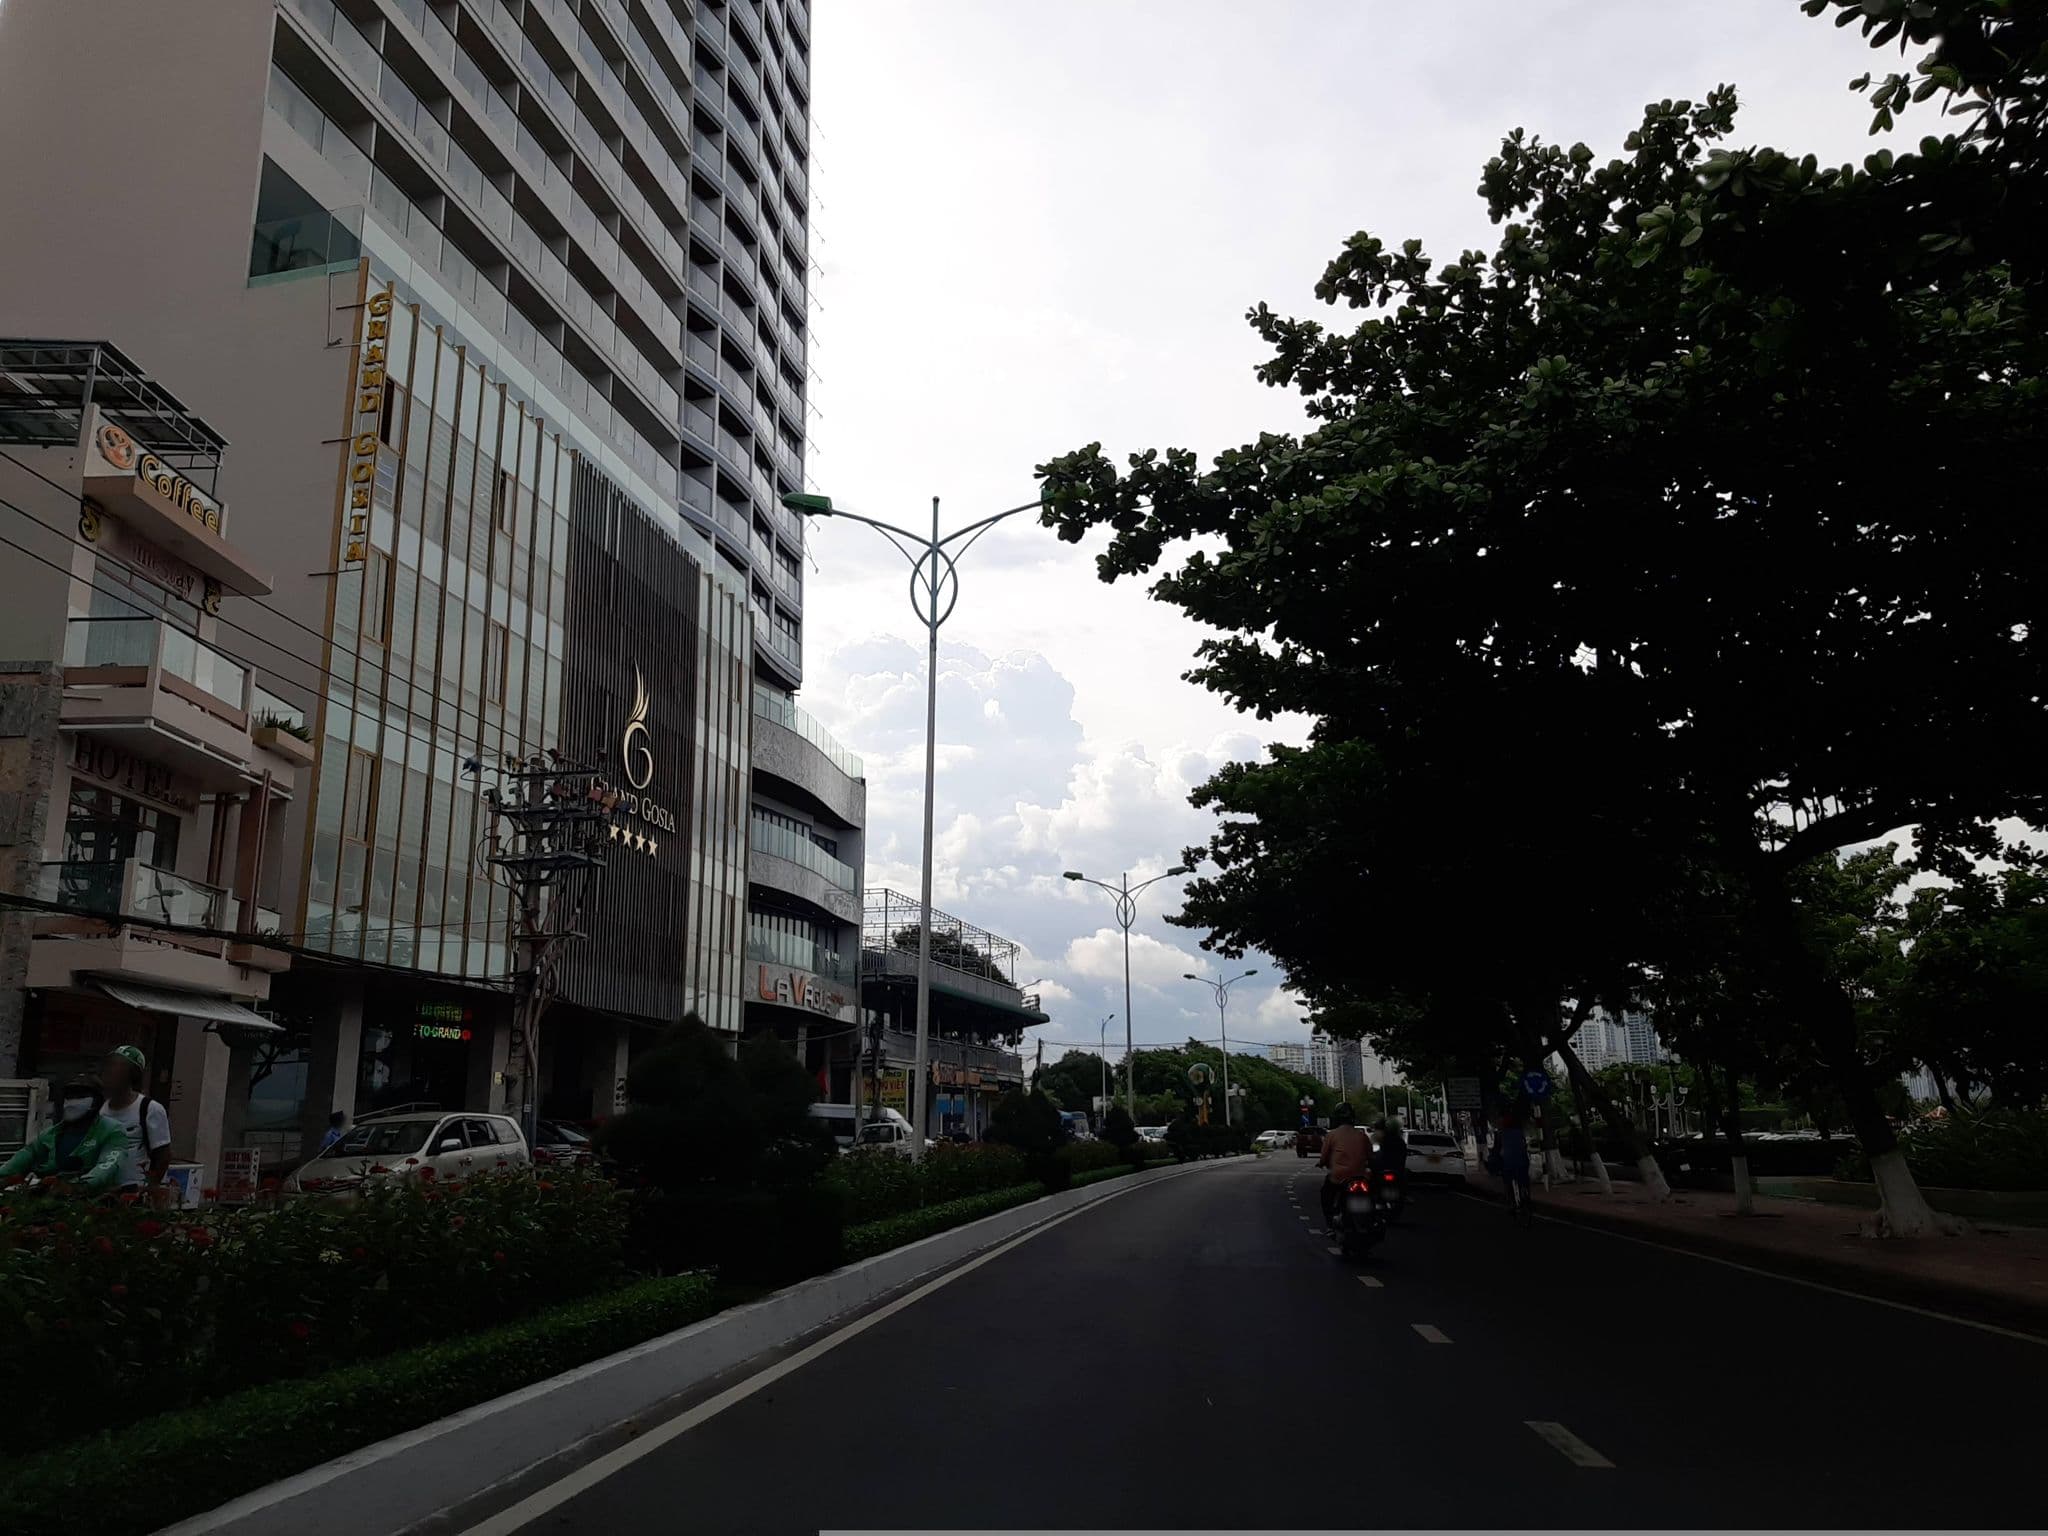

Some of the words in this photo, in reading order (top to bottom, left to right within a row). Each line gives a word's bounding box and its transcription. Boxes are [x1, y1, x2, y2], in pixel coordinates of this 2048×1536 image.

[360, 292, 392, 413] GRAND
[138, 454, 219, 536] Coffee
[345, 432, 378, 562] GOSIA
[642, 797, 676, 833] GOSIA
